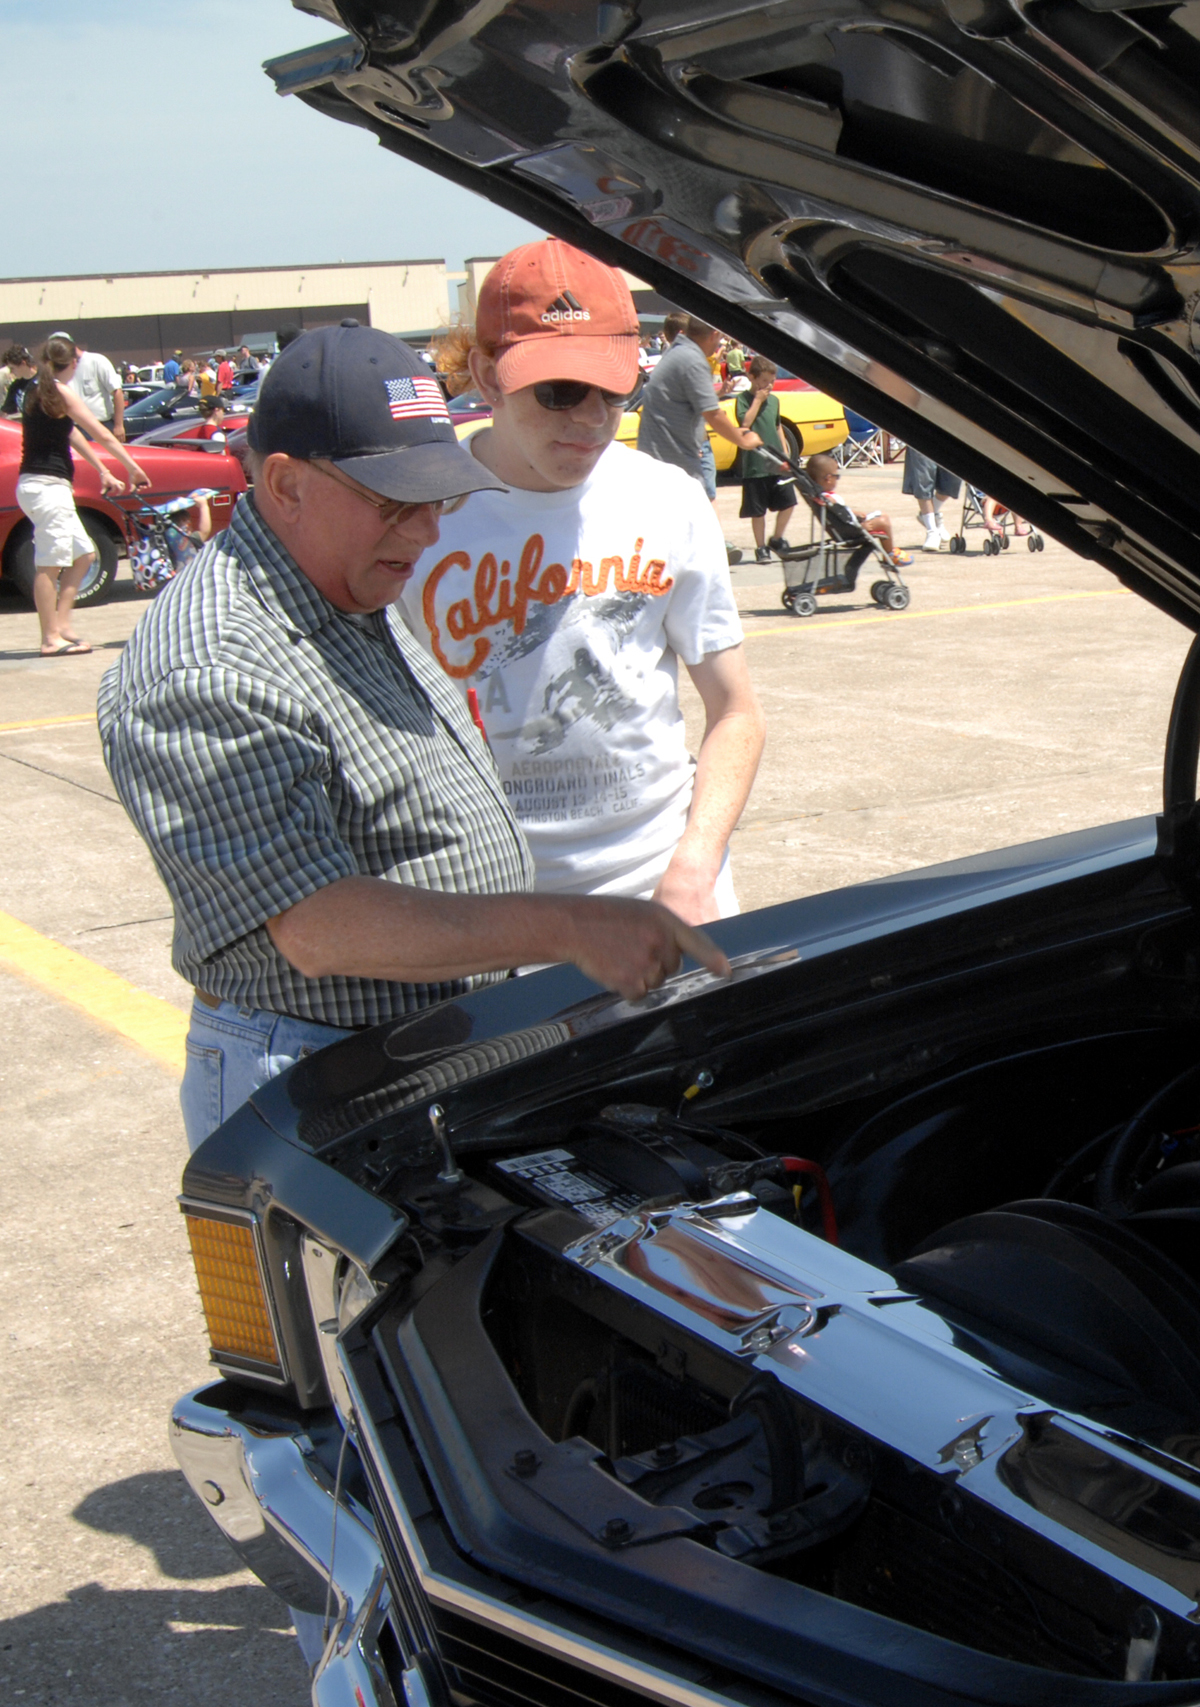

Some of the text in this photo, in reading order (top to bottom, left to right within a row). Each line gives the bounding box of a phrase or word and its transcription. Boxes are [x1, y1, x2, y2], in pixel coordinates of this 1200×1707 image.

[541, 309, 590, 322] adidas
[74, 570, 108, 600] BFGOOD
[423, 533, 673, 679] California
[502, 762, 645, 796] ONGBOARD FINALS
[514, 811, 567, 824] NTINGTON
[570, 806, 604, 820] BEACH
[515, 796, 566, 812] AUGUST
